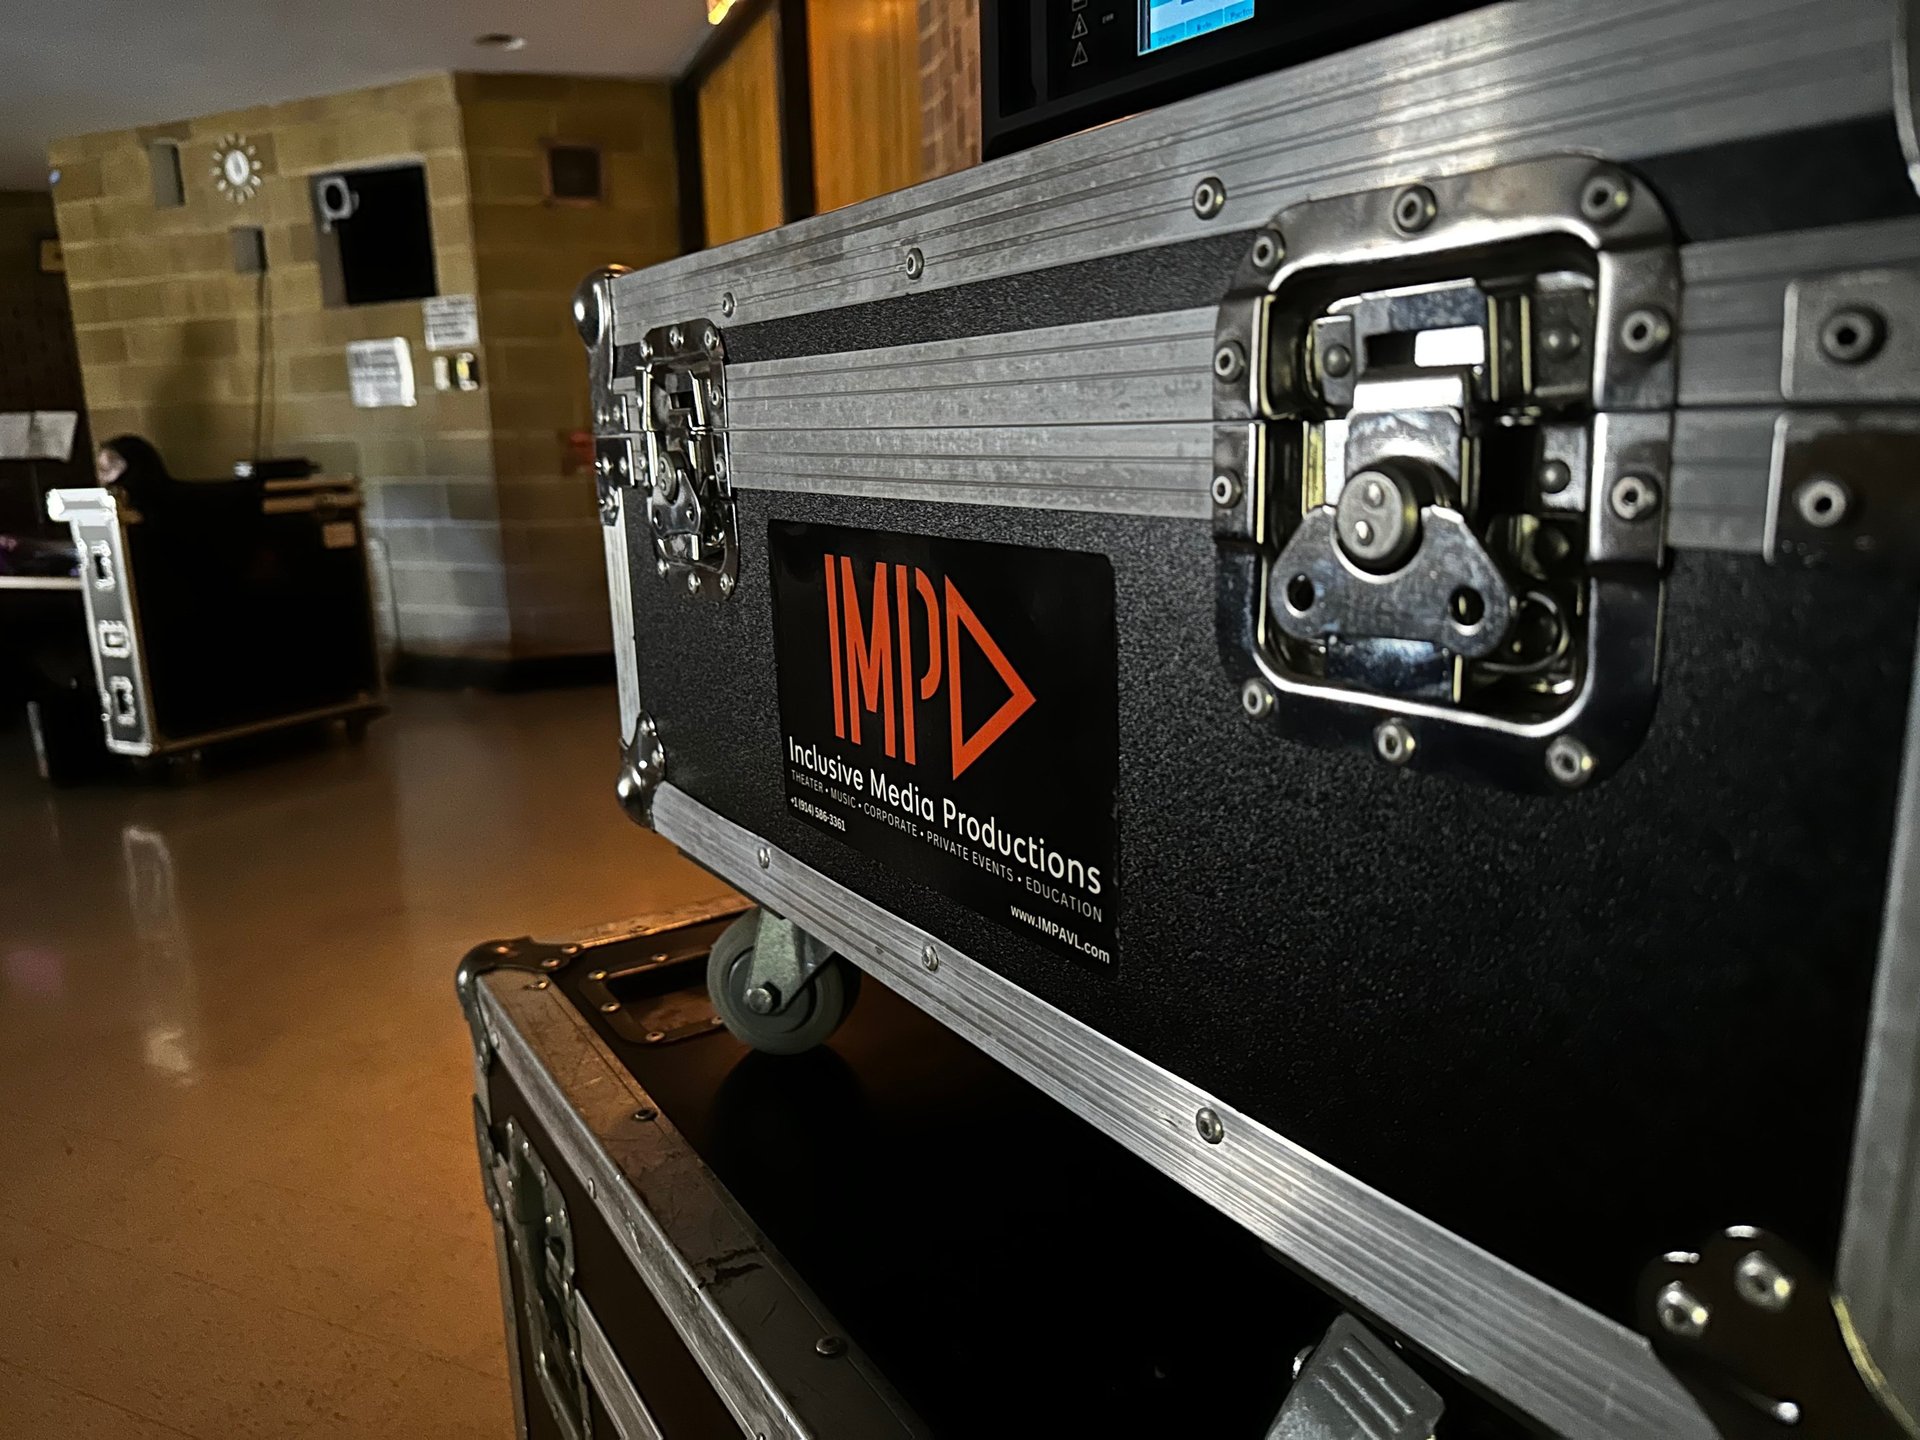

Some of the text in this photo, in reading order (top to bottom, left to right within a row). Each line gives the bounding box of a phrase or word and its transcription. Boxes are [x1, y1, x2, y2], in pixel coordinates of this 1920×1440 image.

[789, 736, 1102, 895] Inclusive Media Productions
[790, 796, 799, 808] +1
[798, 798, 815, 817] (914)
[791, 769, 1103, 923] THEATER MUSIC CORPORATE PRIVATE EVENTS EDUCATION
[1010, 905, 1110, 965] www.IMPAVL.com
